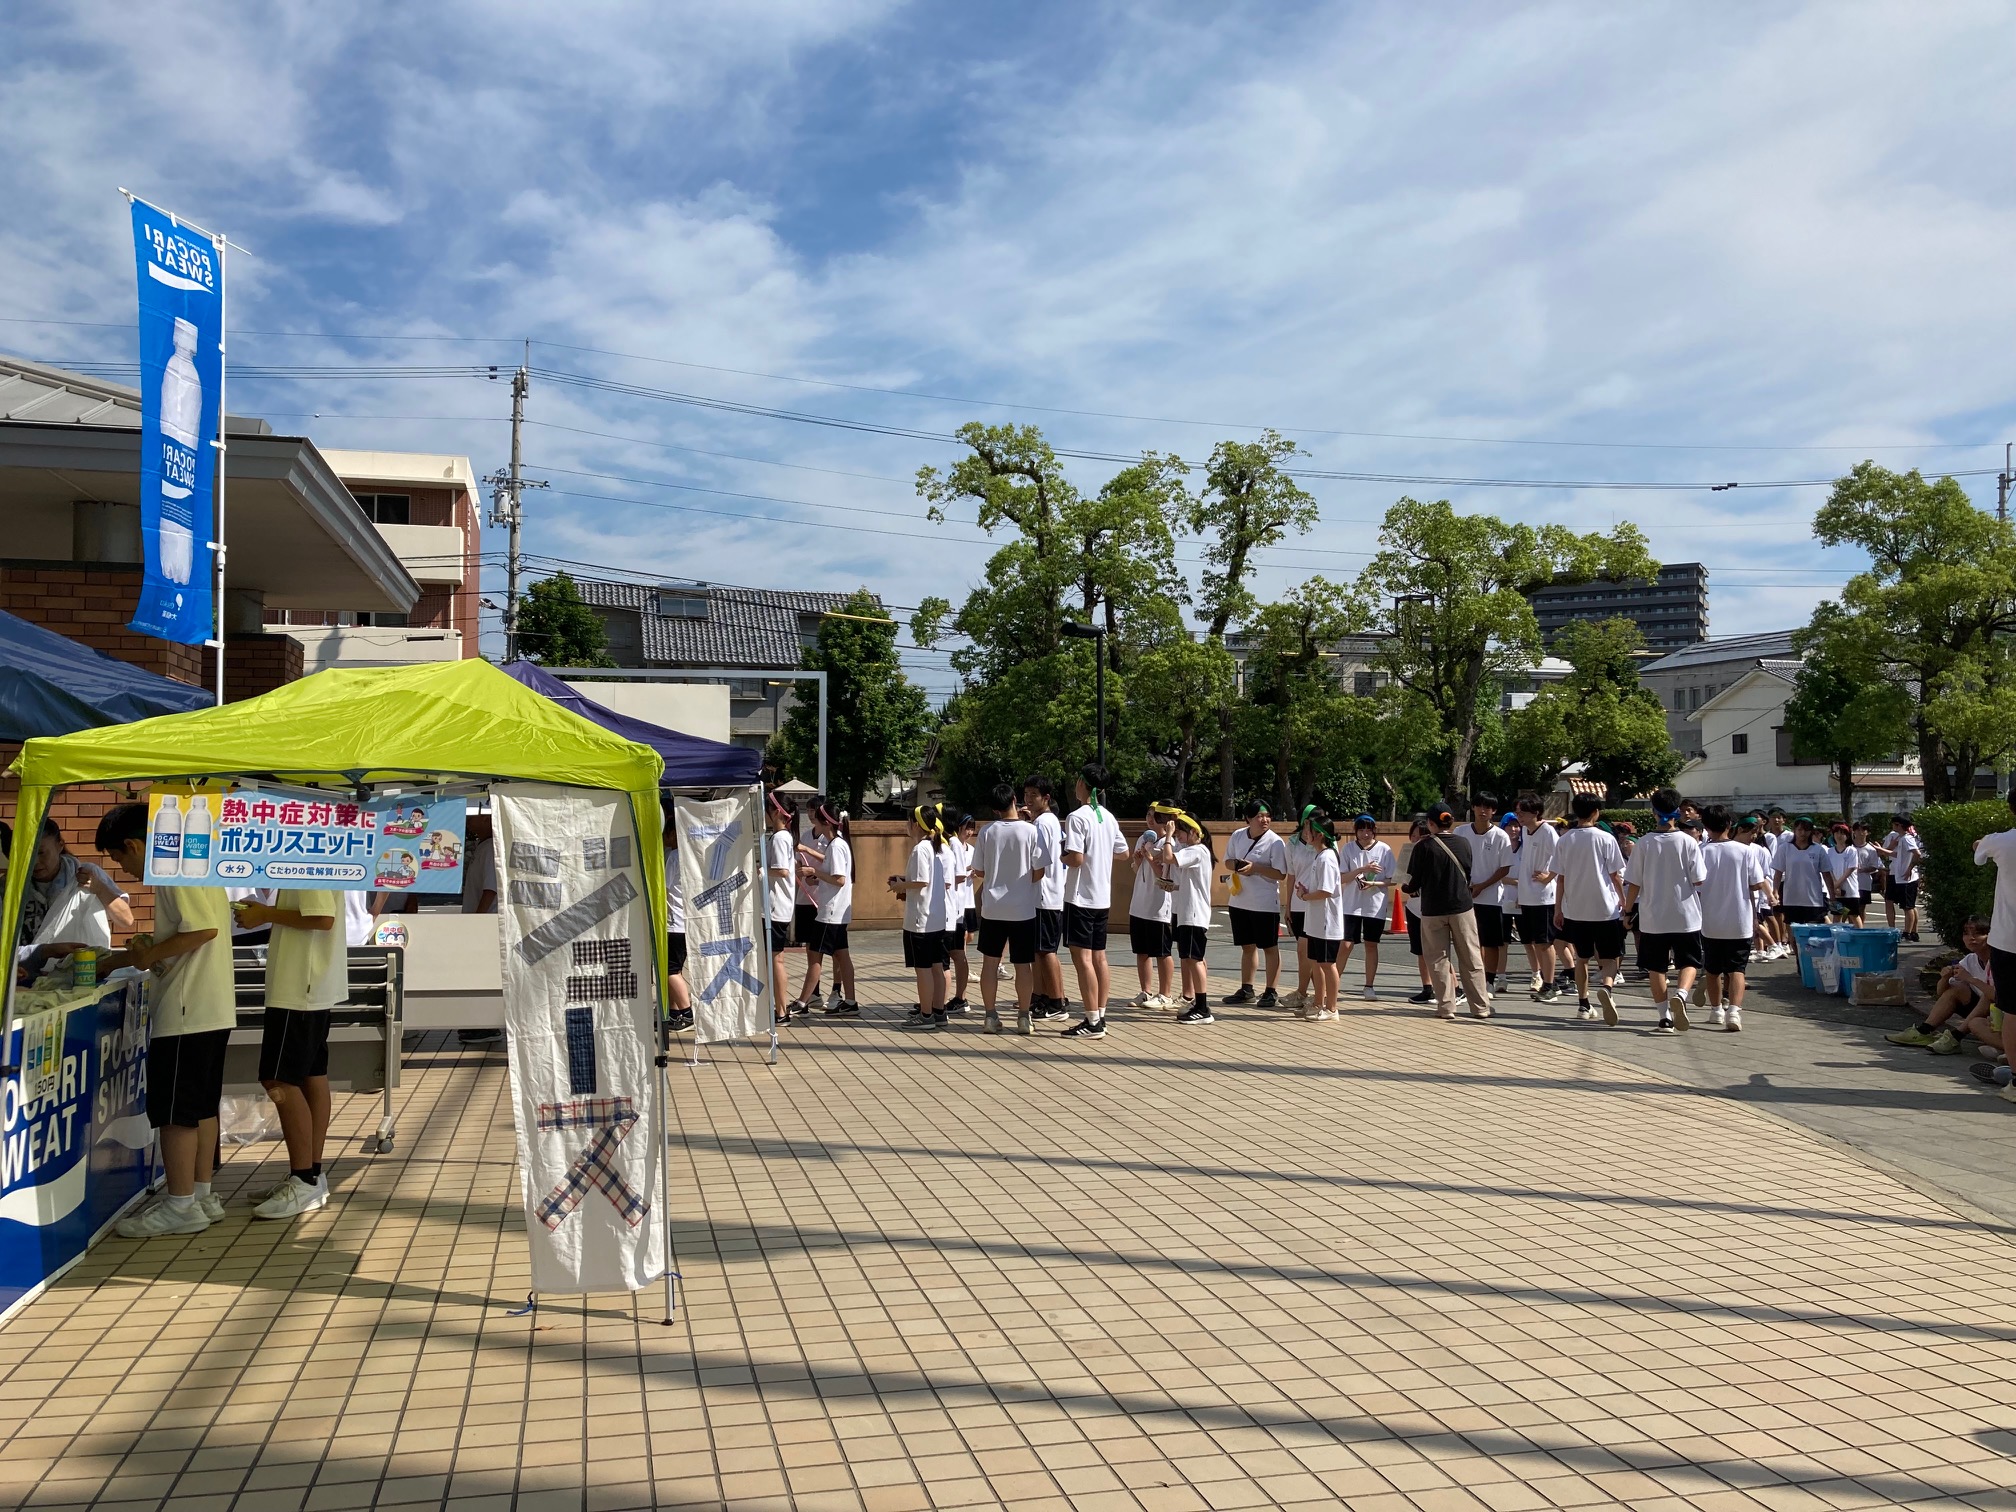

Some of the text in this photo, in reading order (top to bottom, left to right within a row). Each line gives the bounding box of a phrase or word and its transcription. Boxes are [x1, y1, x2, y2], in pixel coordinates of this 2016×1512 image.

[221, 798, 376, 828] 熱中症対策に
[220, 826, 375, 856] ポカリスエット!
[225, 864, 246, 874] 水分
[269, 866, 363, 877] こだわりの電解質バランス
[686, 819, 766, 1006] アイス
[508, 834, 652, 1232] ジュース
